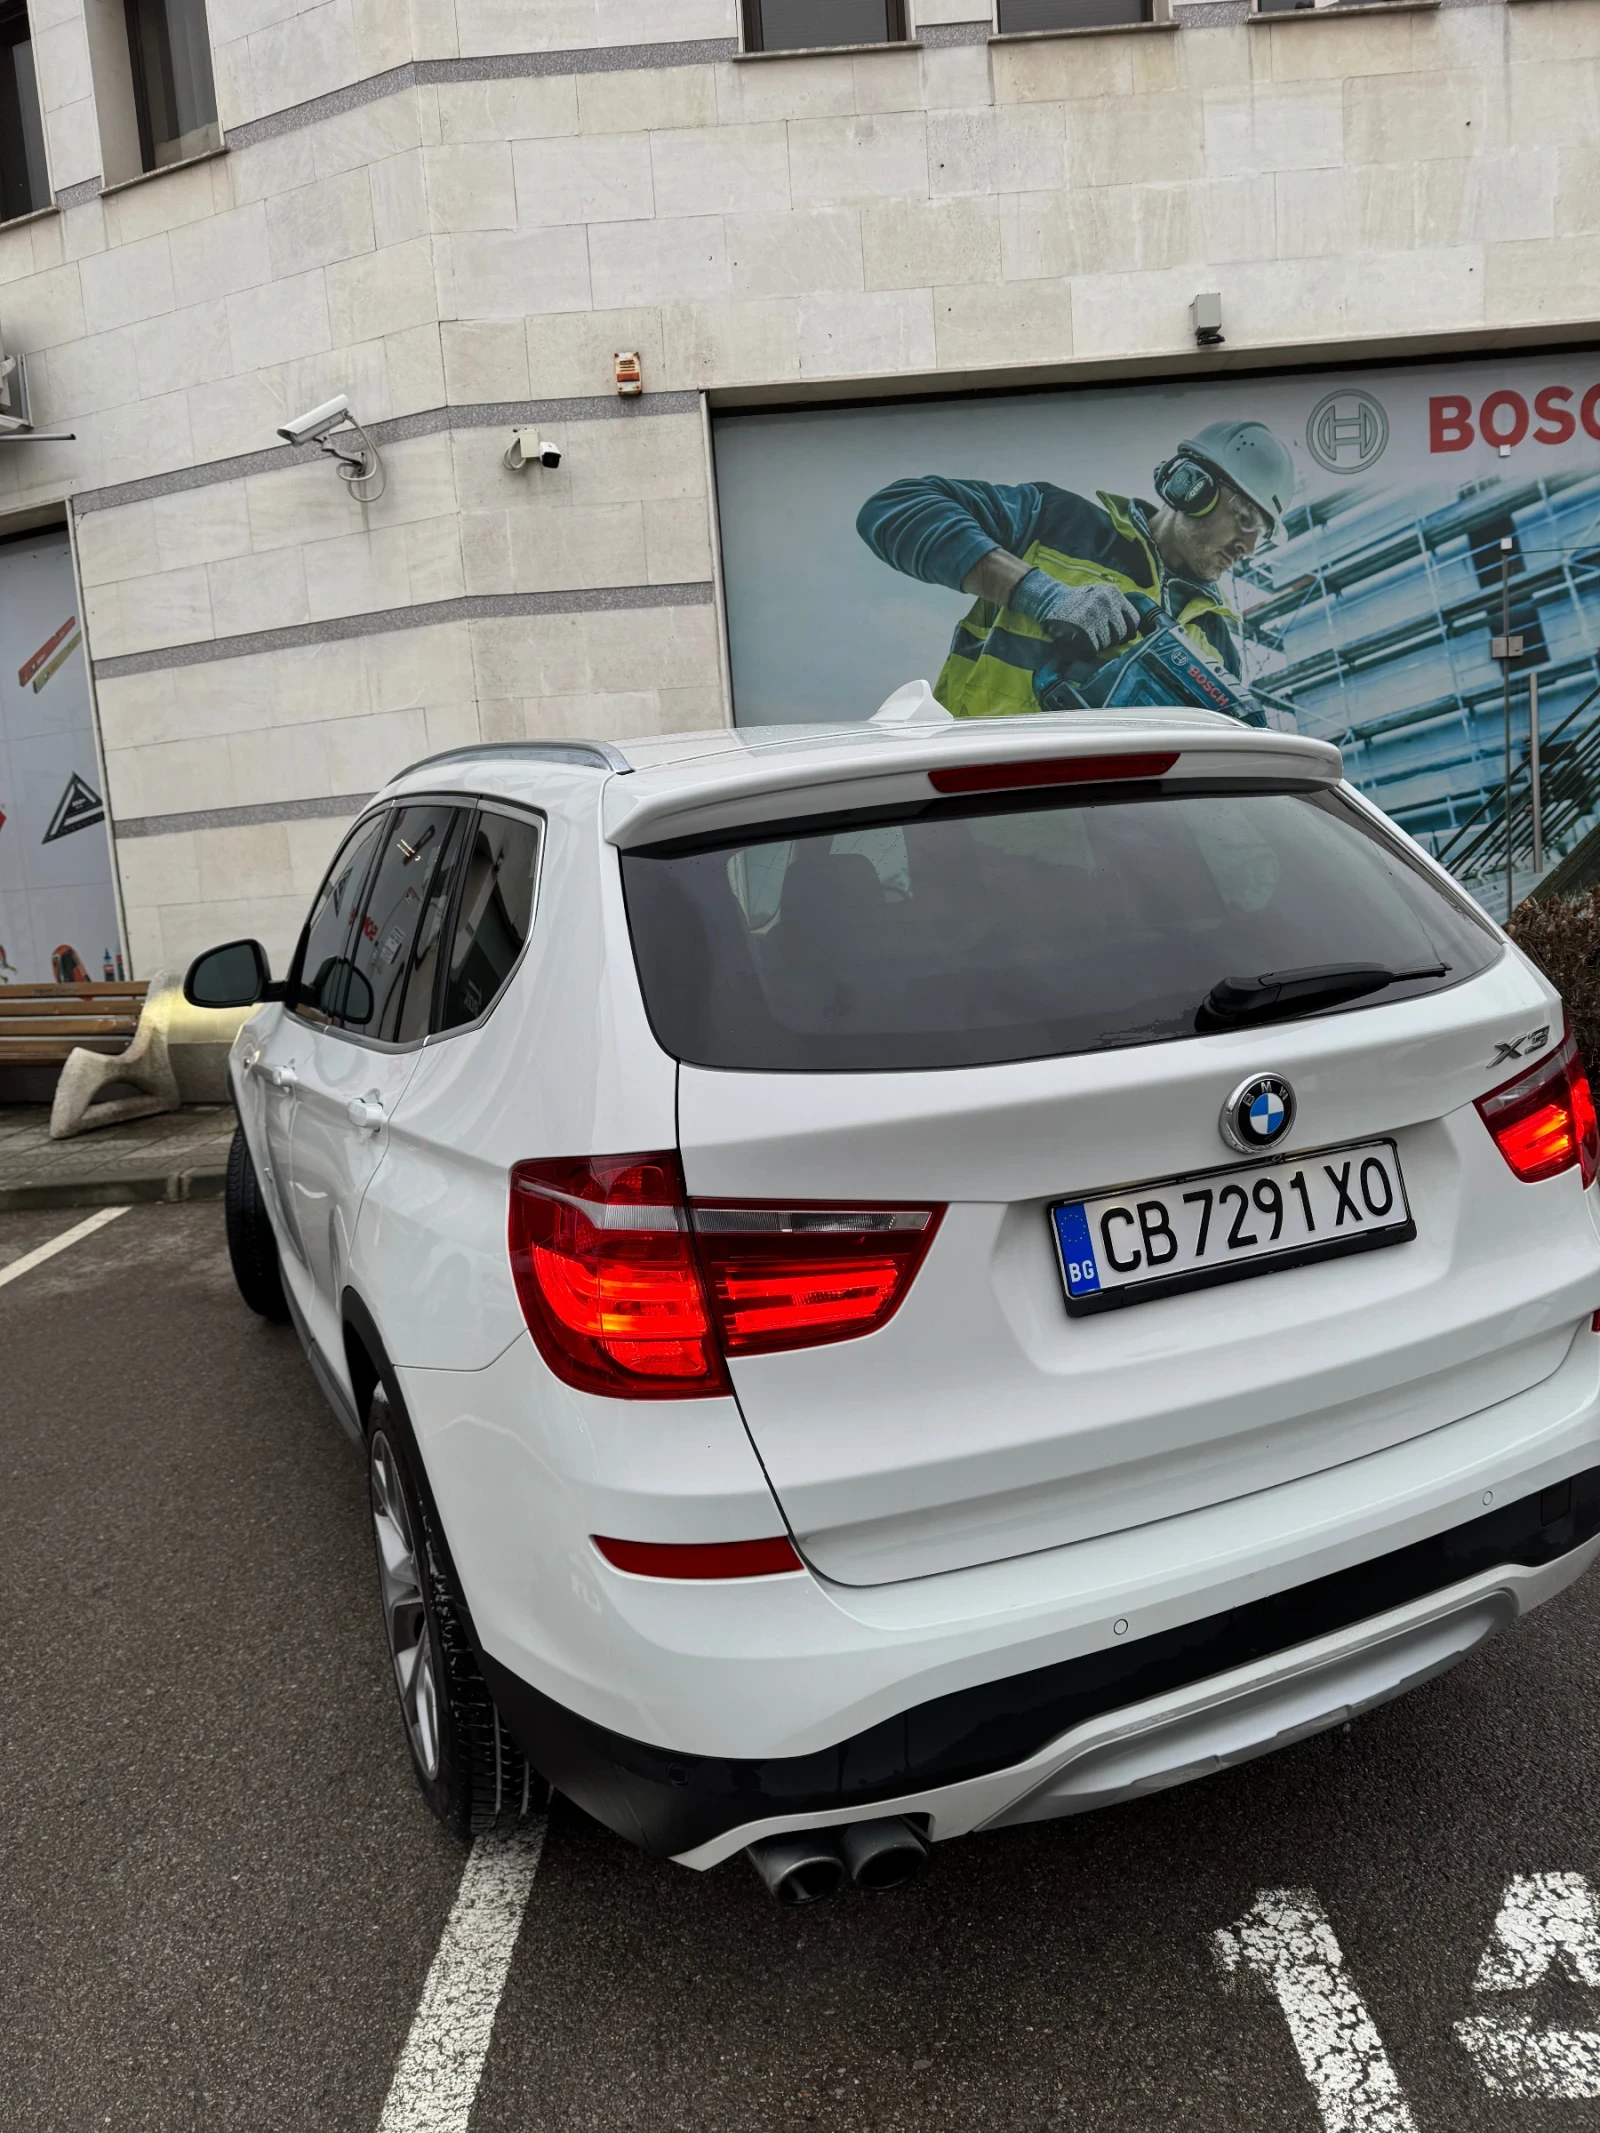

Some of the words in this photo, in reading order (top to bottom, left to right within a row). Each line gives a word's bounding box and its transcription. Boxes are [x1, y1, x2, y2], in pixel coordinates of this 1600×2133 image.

[1187, 666, 1230, 707] BOSCH
[1486, 1025, 1550, 1069] X3
[1242, 1080, 1289, 1107] BMW
[1068, 1259, 1095, 1284] BG
